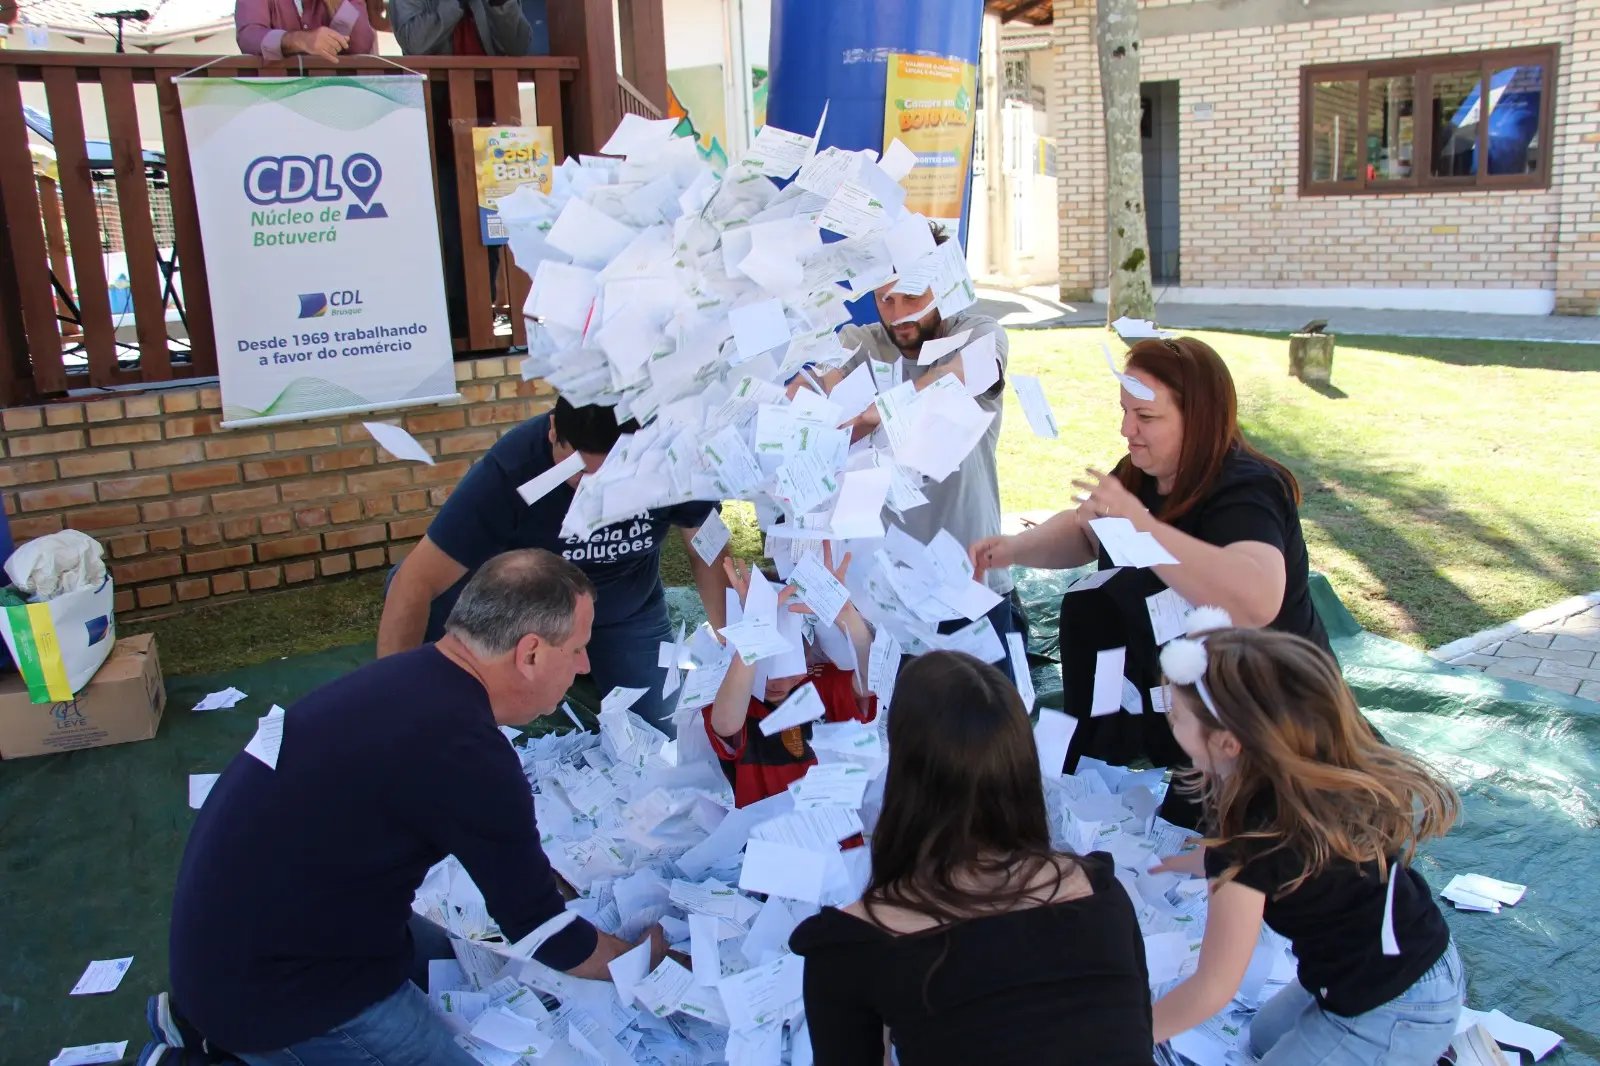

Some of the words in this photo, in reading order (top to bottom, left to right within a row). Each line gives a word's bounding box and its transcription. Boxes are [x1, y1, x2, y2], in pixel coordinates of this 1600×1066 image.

[245, 155, 342, 204] CDL
[251, 208, 314, 227] Núcleo
[319, 206, 341, 223] de
[253, 225, 337, 247] Botuverá
[330, 290, 363, 306] CDL
[331, 308, 362, 316] Brusque
[237, 336, 288, 352] Desde
[292, 332, 330, 347] 1969
[334, 323, 428, 342] trabalhando
[259, 355, 269, 366] a
[272, 350, 313, 364] favor
[317, 347, 338, 359] do
[342, 339, 412, 357] comércio
[562, 536, 653, 561] soluções
[56, 719, 87, 729] LEVE
